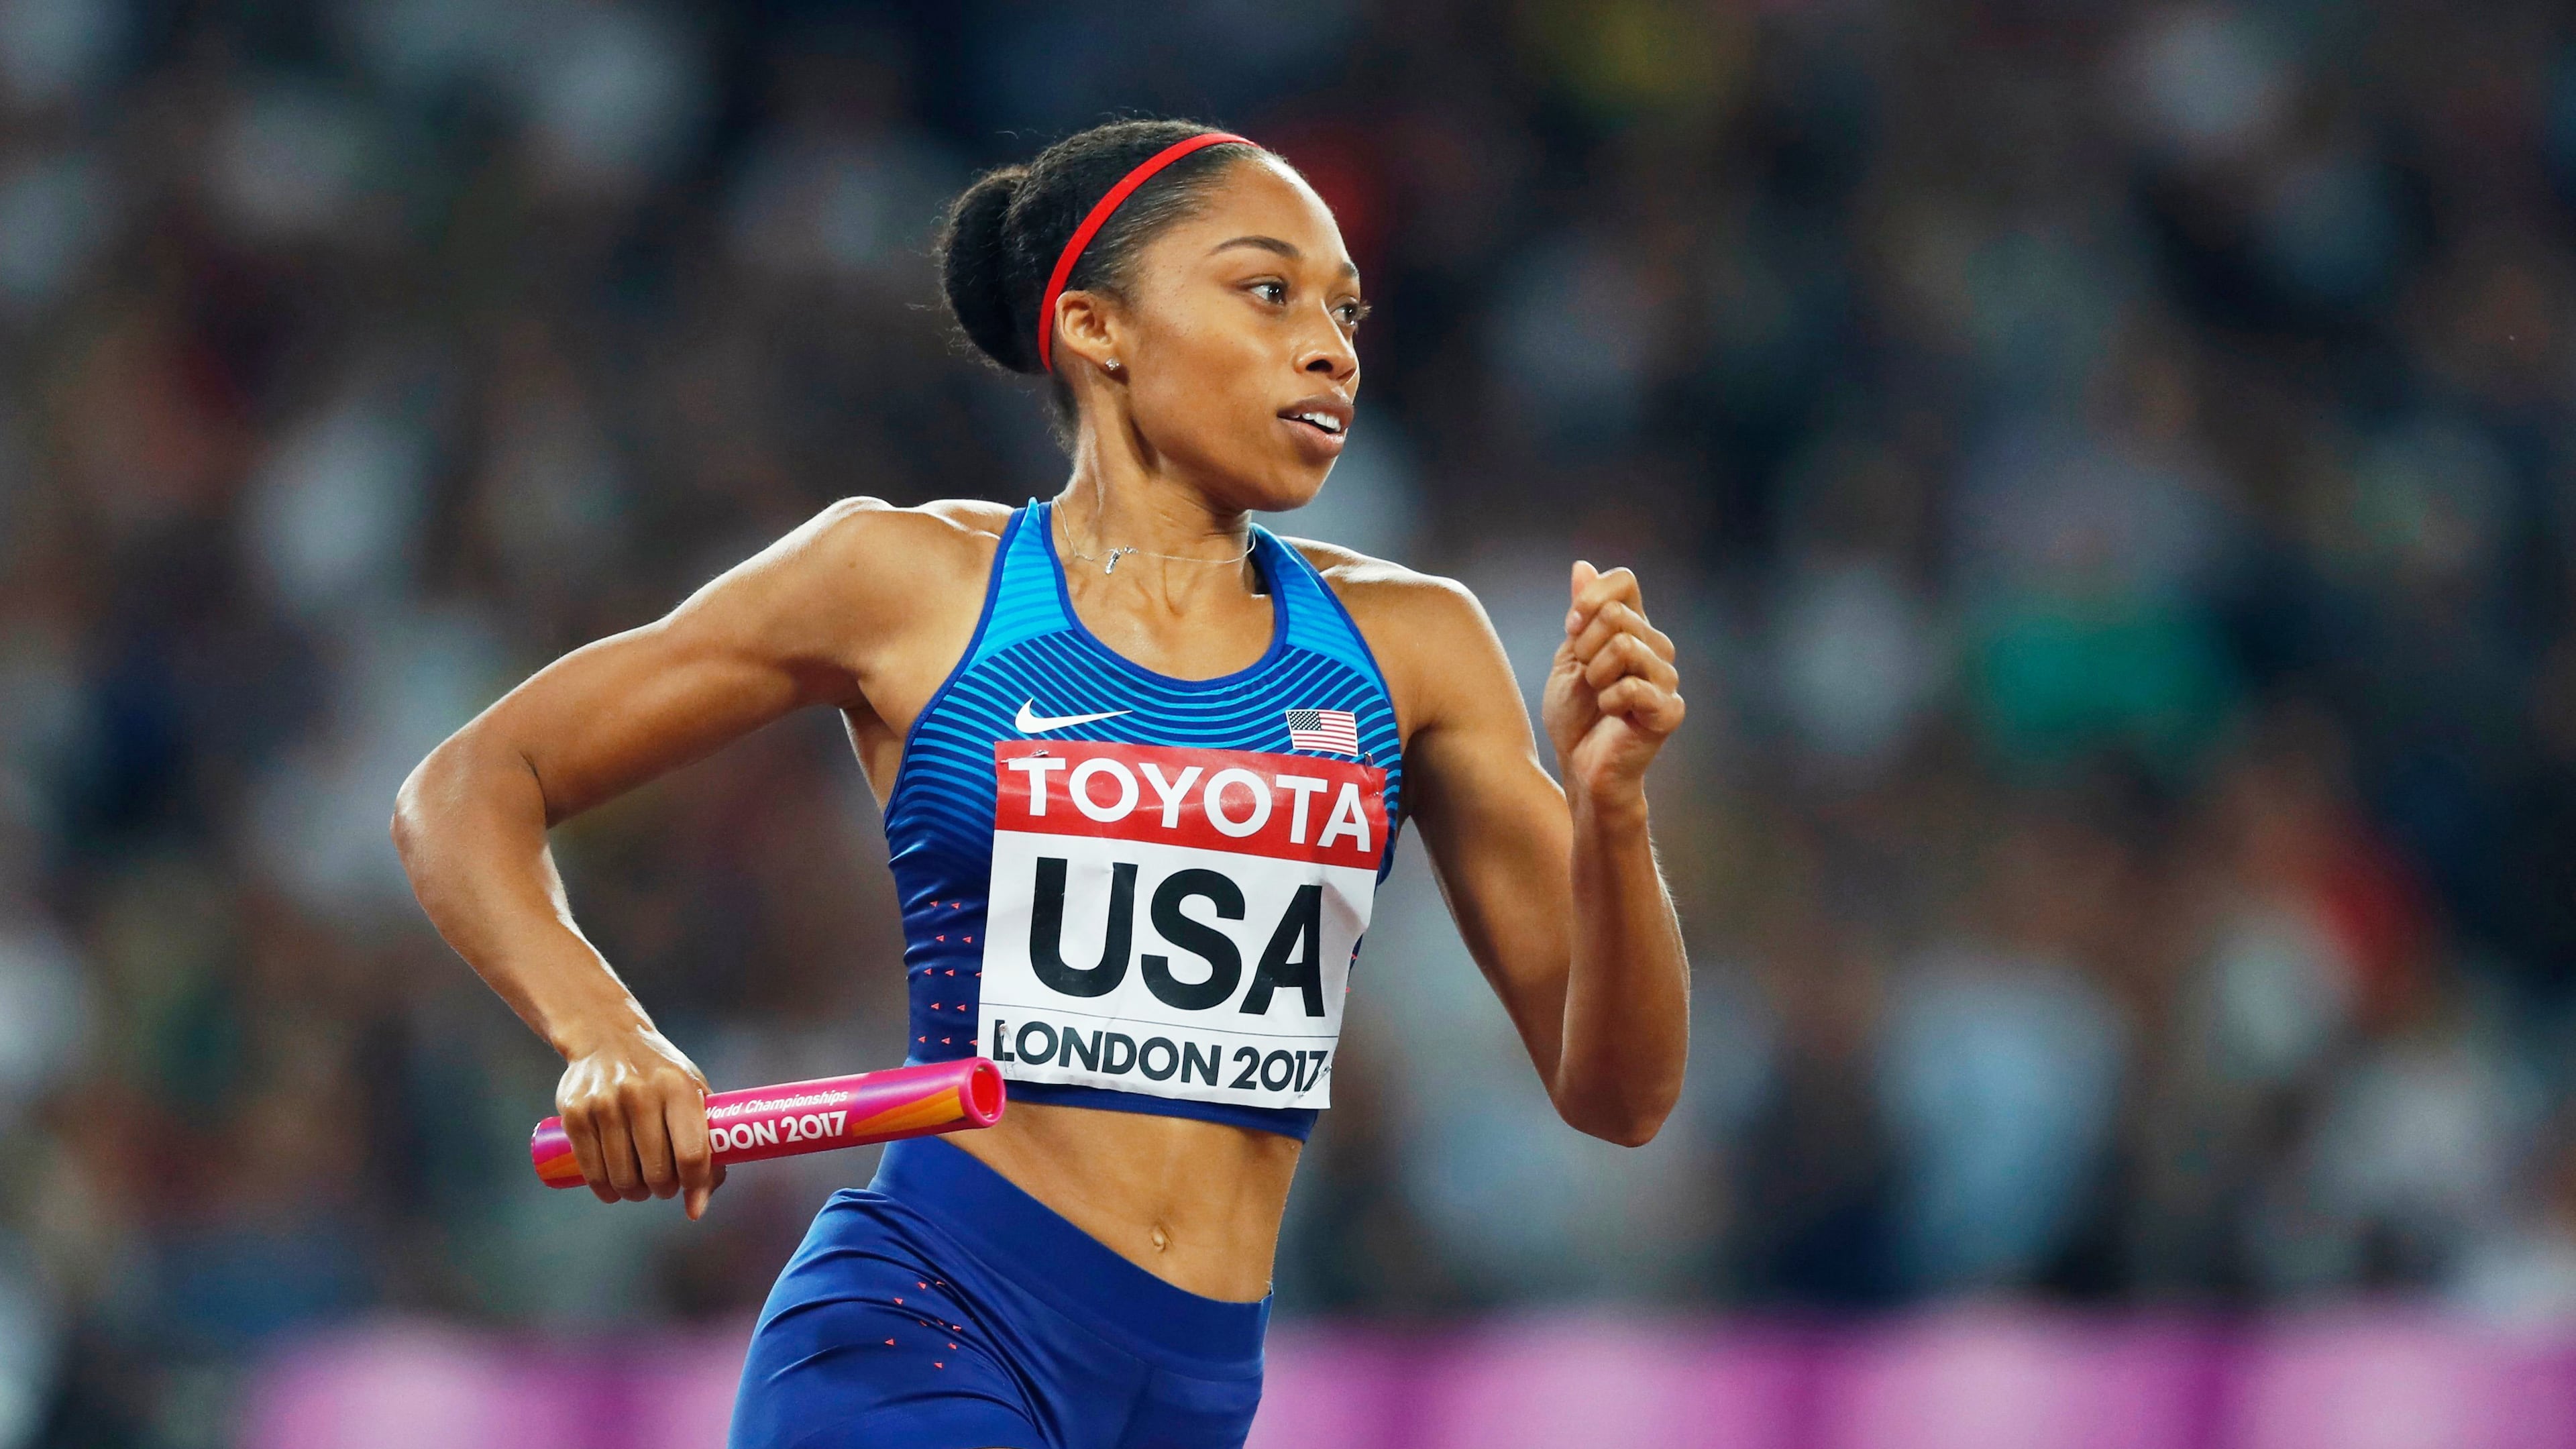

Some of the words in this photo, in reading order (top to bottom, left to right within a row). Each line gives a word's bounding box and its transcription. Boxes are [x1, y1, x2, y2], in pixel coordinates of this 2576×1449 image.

[1008, 757, 1371, 852] TOYOTA
[1029, 857, 1326, 1018] USA
[992, 1019, 1222, 1087] LONDON
[1228, 1046, 1328, 1093] 2017
[705, 1102, 743, 1120] World
[745, 1089, 849, 1113] Championships
[709, 1119, 780, 1153] DON
[780, 1110, 848, 1142] 2017
